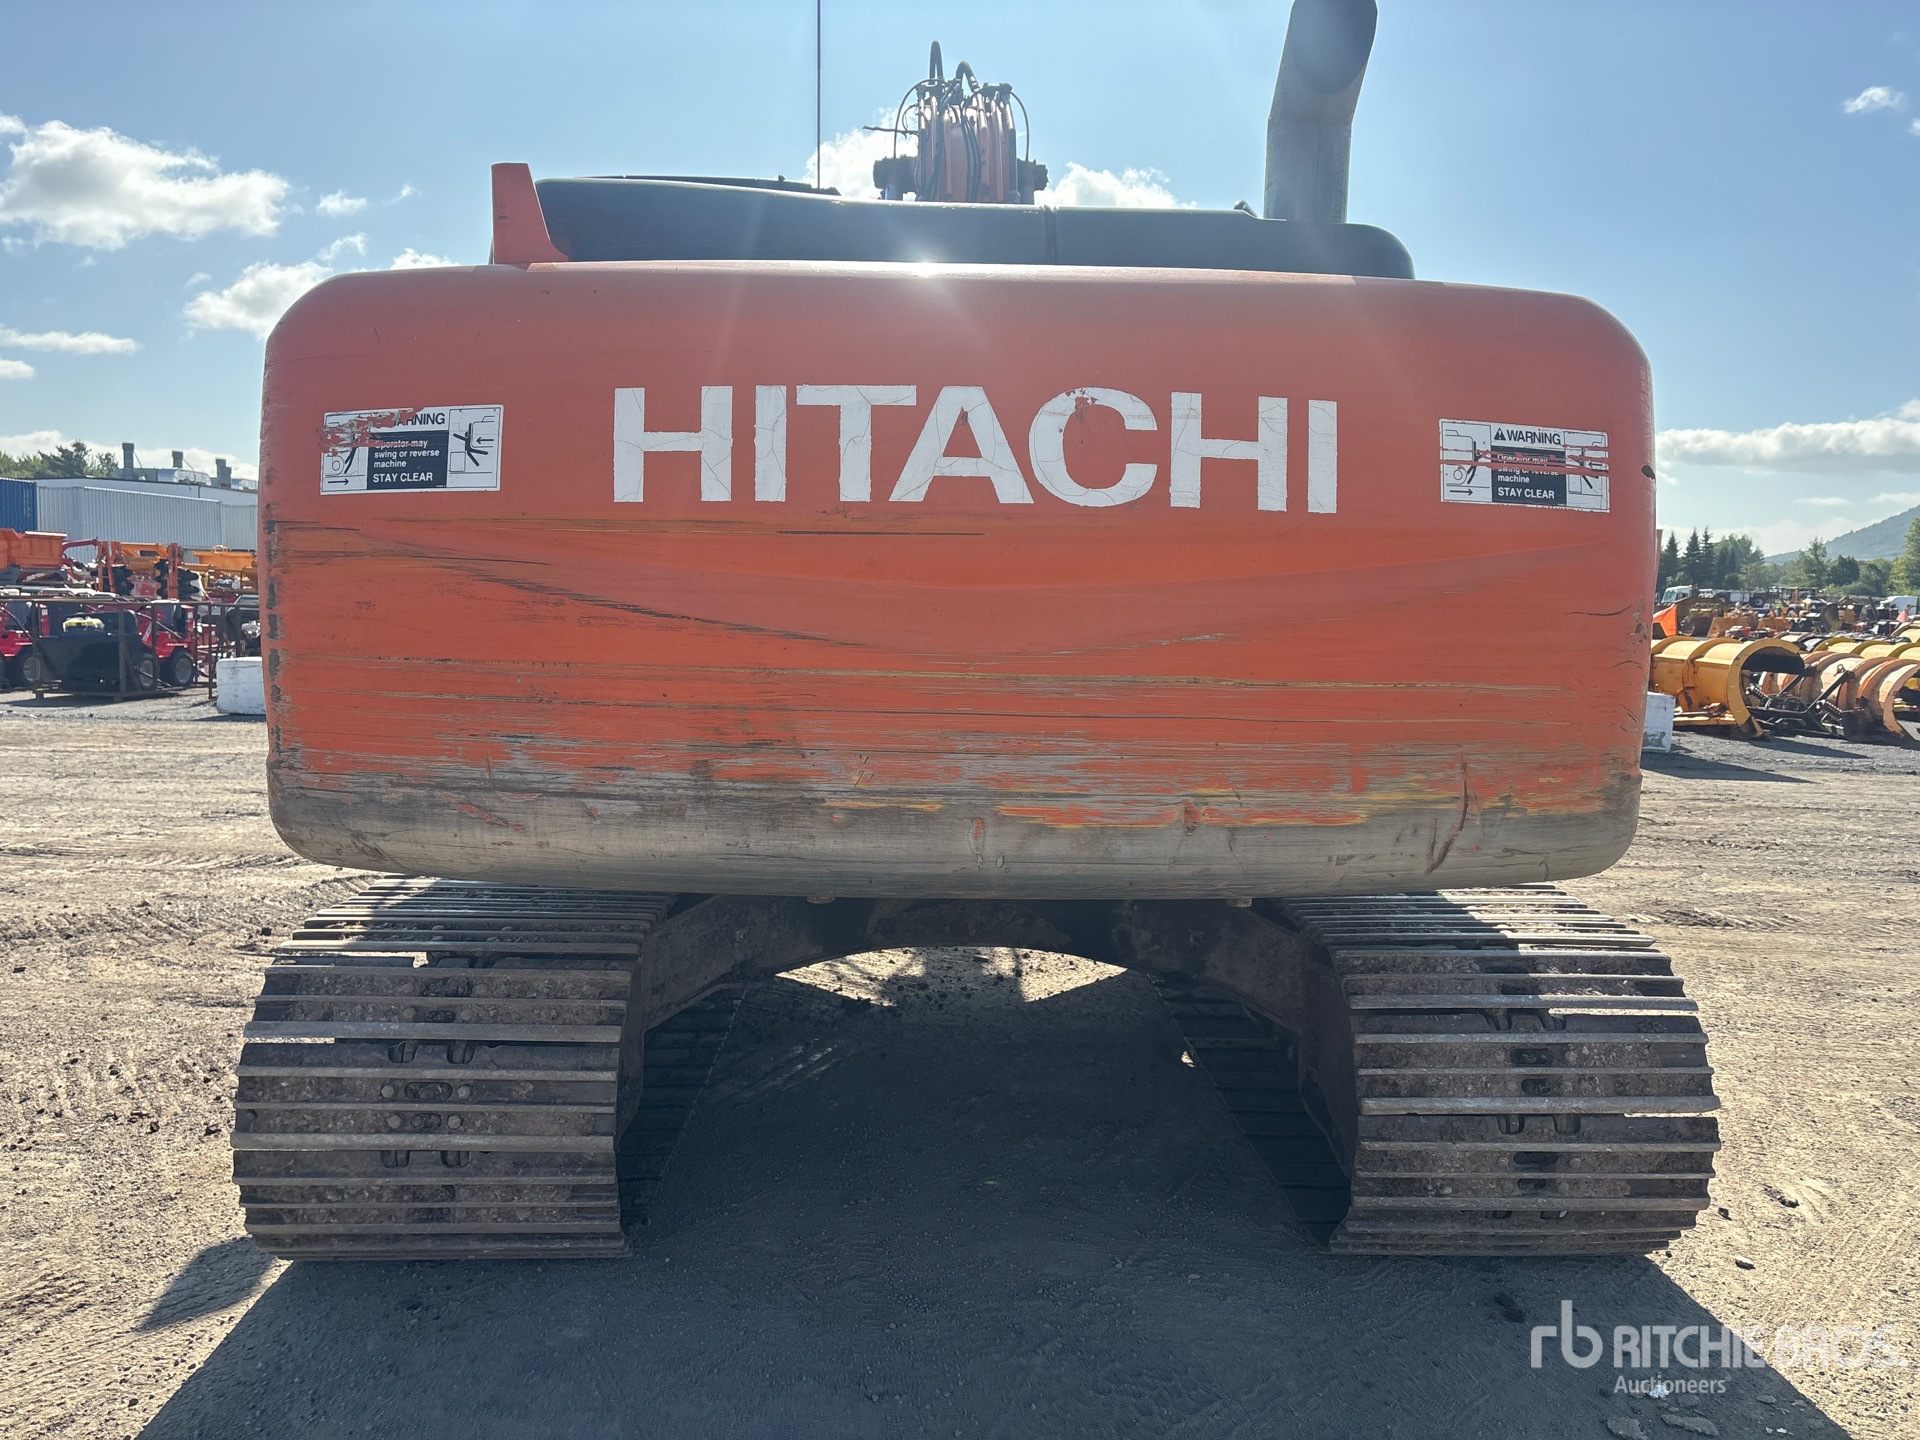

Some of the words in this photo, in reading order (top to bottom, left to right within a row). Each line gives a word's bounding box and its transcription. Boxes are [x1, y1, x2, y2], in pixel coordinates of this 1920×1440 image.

[394, 412, 446, 427] RNING
[1506, 430, 1561, 445] WARNING
[374, 451, 397, 461] swing
[399, 451, 408, 459] or
[409, 449, 440, 458] reverse
[613, 384, 1338, 514] HITACHI
[373, 460, 407, 469] machine
[372, 473, 397, 483] STAY
[400, 472, 433, 483] CLEAR
[1498, 475, 1530, 483] machine
[1498, 487, 1523, 497] STAY
[1524, 489, 1555, 499] CLEAR
